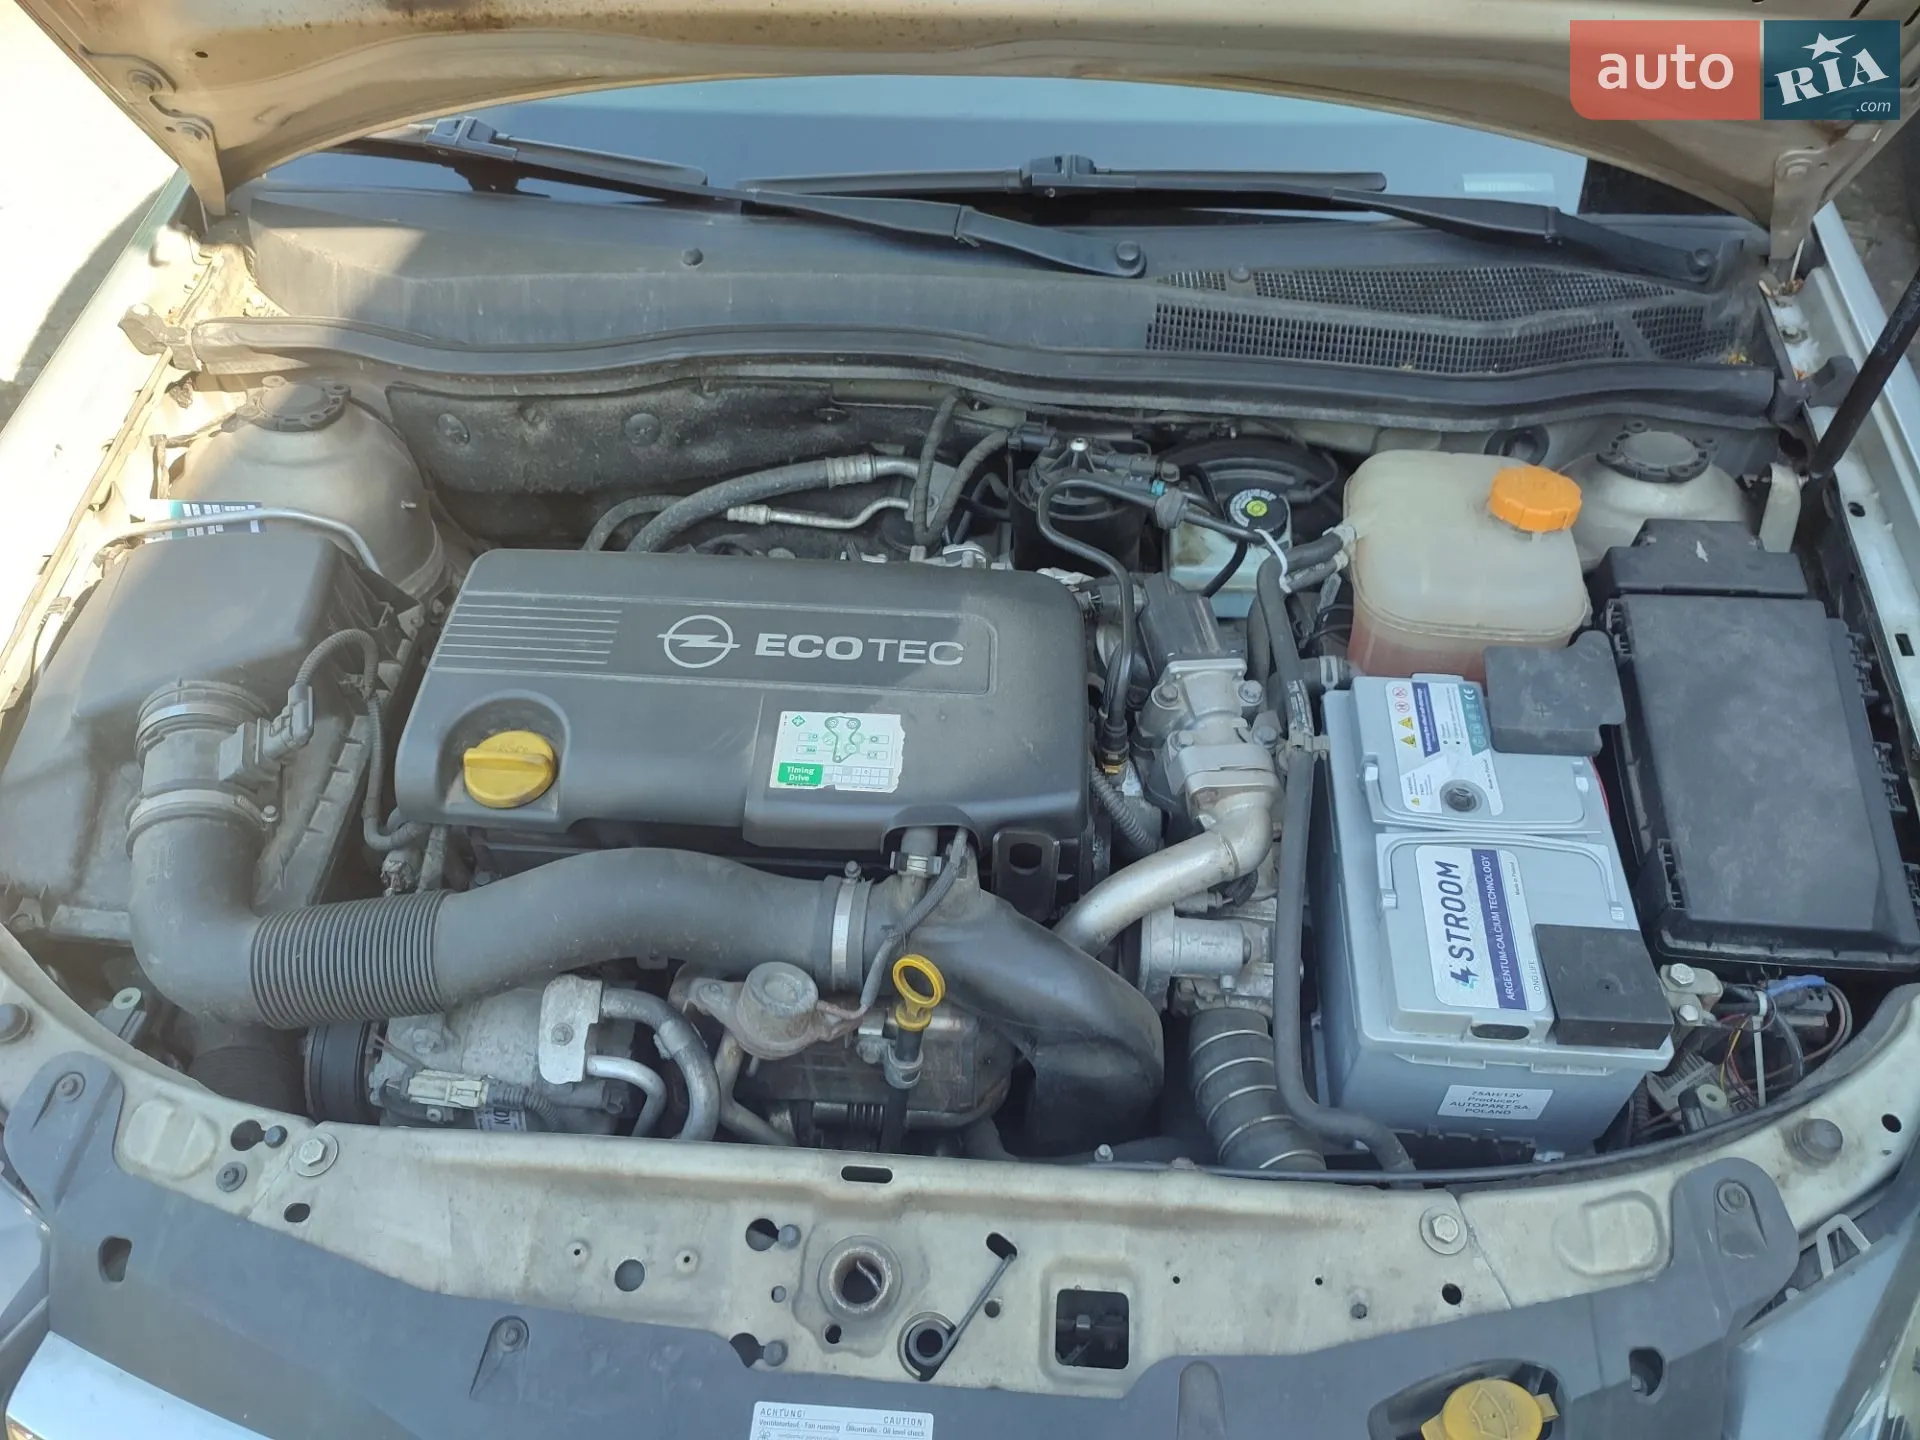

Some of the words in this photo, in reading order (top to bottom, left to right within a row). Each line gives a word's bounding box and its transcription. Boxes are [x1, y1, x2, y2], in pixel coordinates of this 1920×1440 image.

[755, 633, 964, 665] ECOTEC
[787, 766, 815, 775] Timing
[1481, 855, 1499, 910] TECHNOLOGY
[1434, 861, 1474, 962] STROOM
[1492, 911, 1516, 1001] ARGENTUM-CALCIUM
[1449, 1101, 1510, 1109] AUTOPART
[760, 1407, 806, 1418] ACHTUNG!
[883, 1416, 926, 1426] CAUTION!
